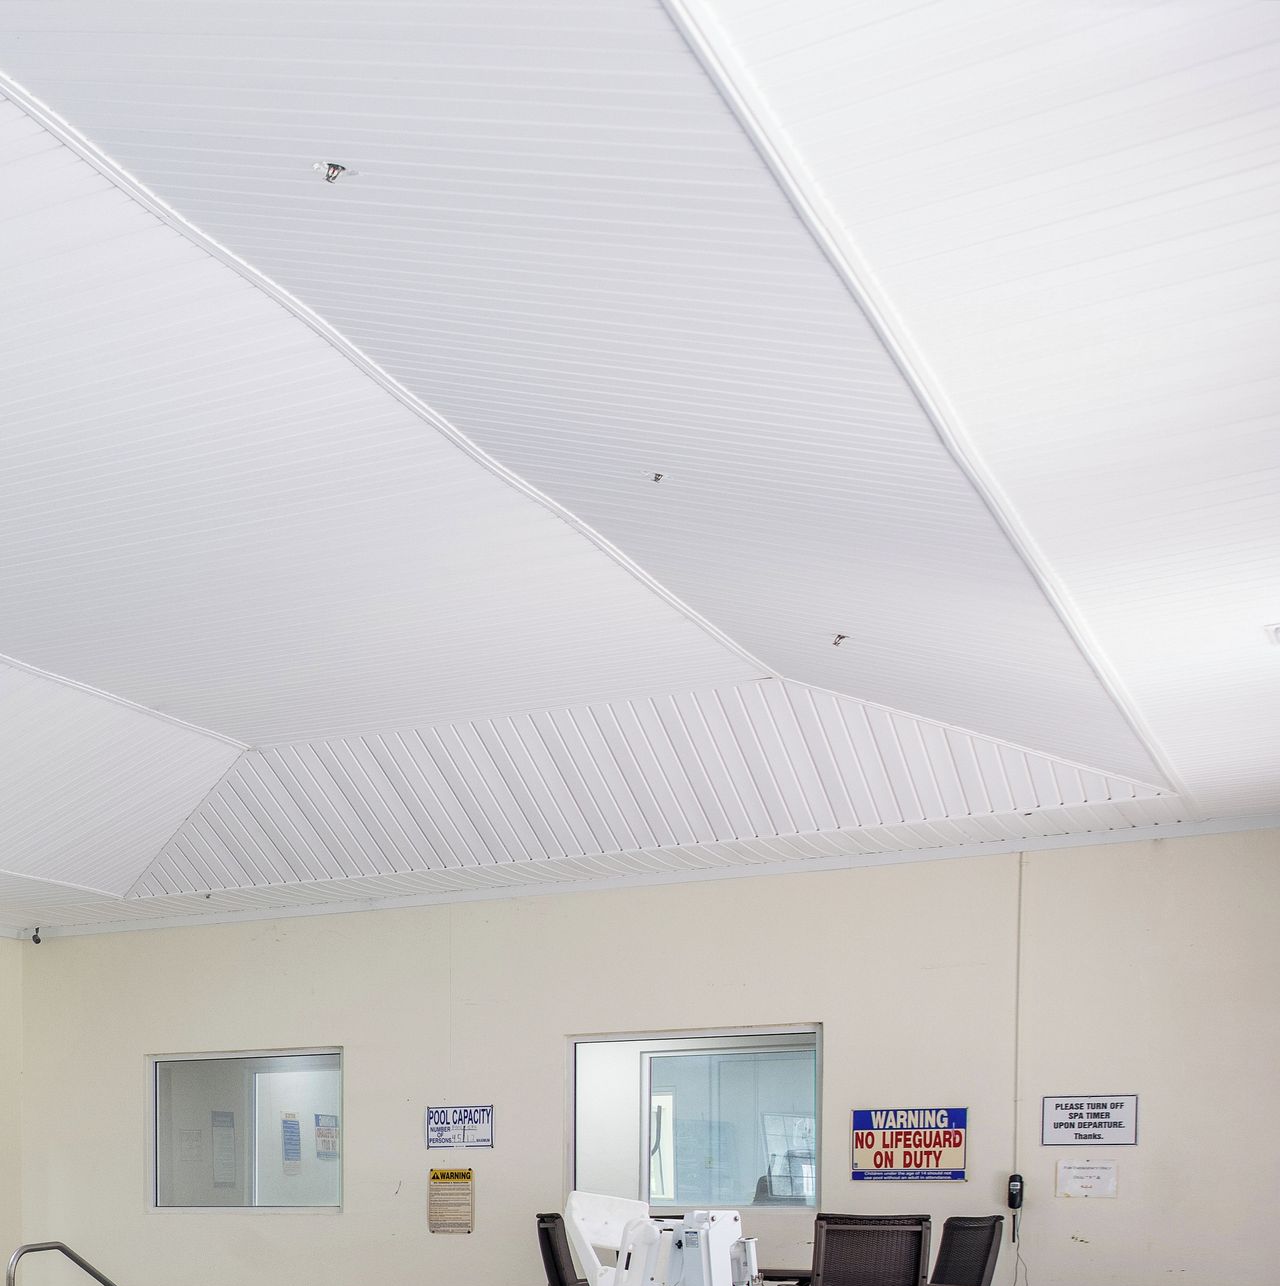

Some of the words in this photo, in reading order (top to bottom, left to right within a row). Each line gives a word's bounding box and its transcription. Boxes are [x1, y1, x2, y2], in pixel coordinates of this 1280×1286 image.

[429, 1110, 450, 1125] POOL
[452, 1109, 491, 1124] CAPACITY
[871, 1110, 948, 1128] WARNING
[855, 1131, 875, 1149] NO
[882, 1130, 962, 1148] LIFEGUARD
[873, 1151, 894, 1168] ON
[903, 1151, 942, 1168] DUTY
